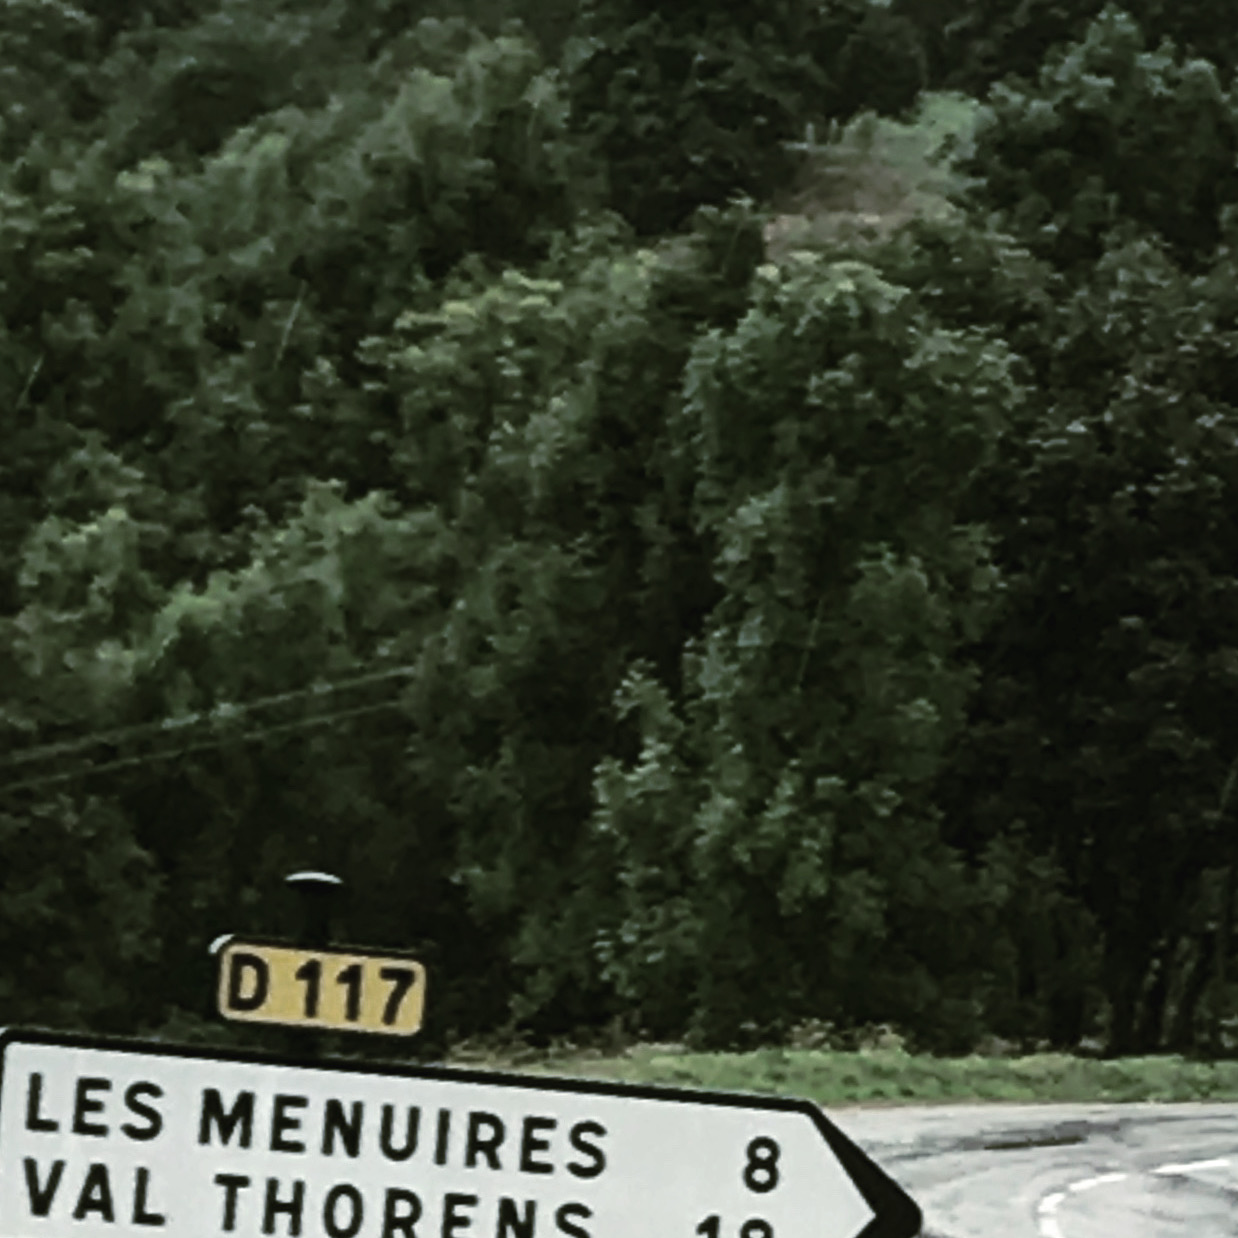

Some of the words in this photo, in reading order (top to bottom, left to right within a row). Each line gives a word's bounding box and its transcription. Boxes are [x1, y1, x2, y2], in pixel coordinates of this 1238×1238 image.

[227, 952, 270, 1012] D
[294, 958, 417, 1026] 117
[25, 1072, 164, 1141] LES
[198, 1088, 609, 1179] MENUIRES
[742, 1135, 782, 1194] 8
[23, 1157, 166, 1227] VAL
